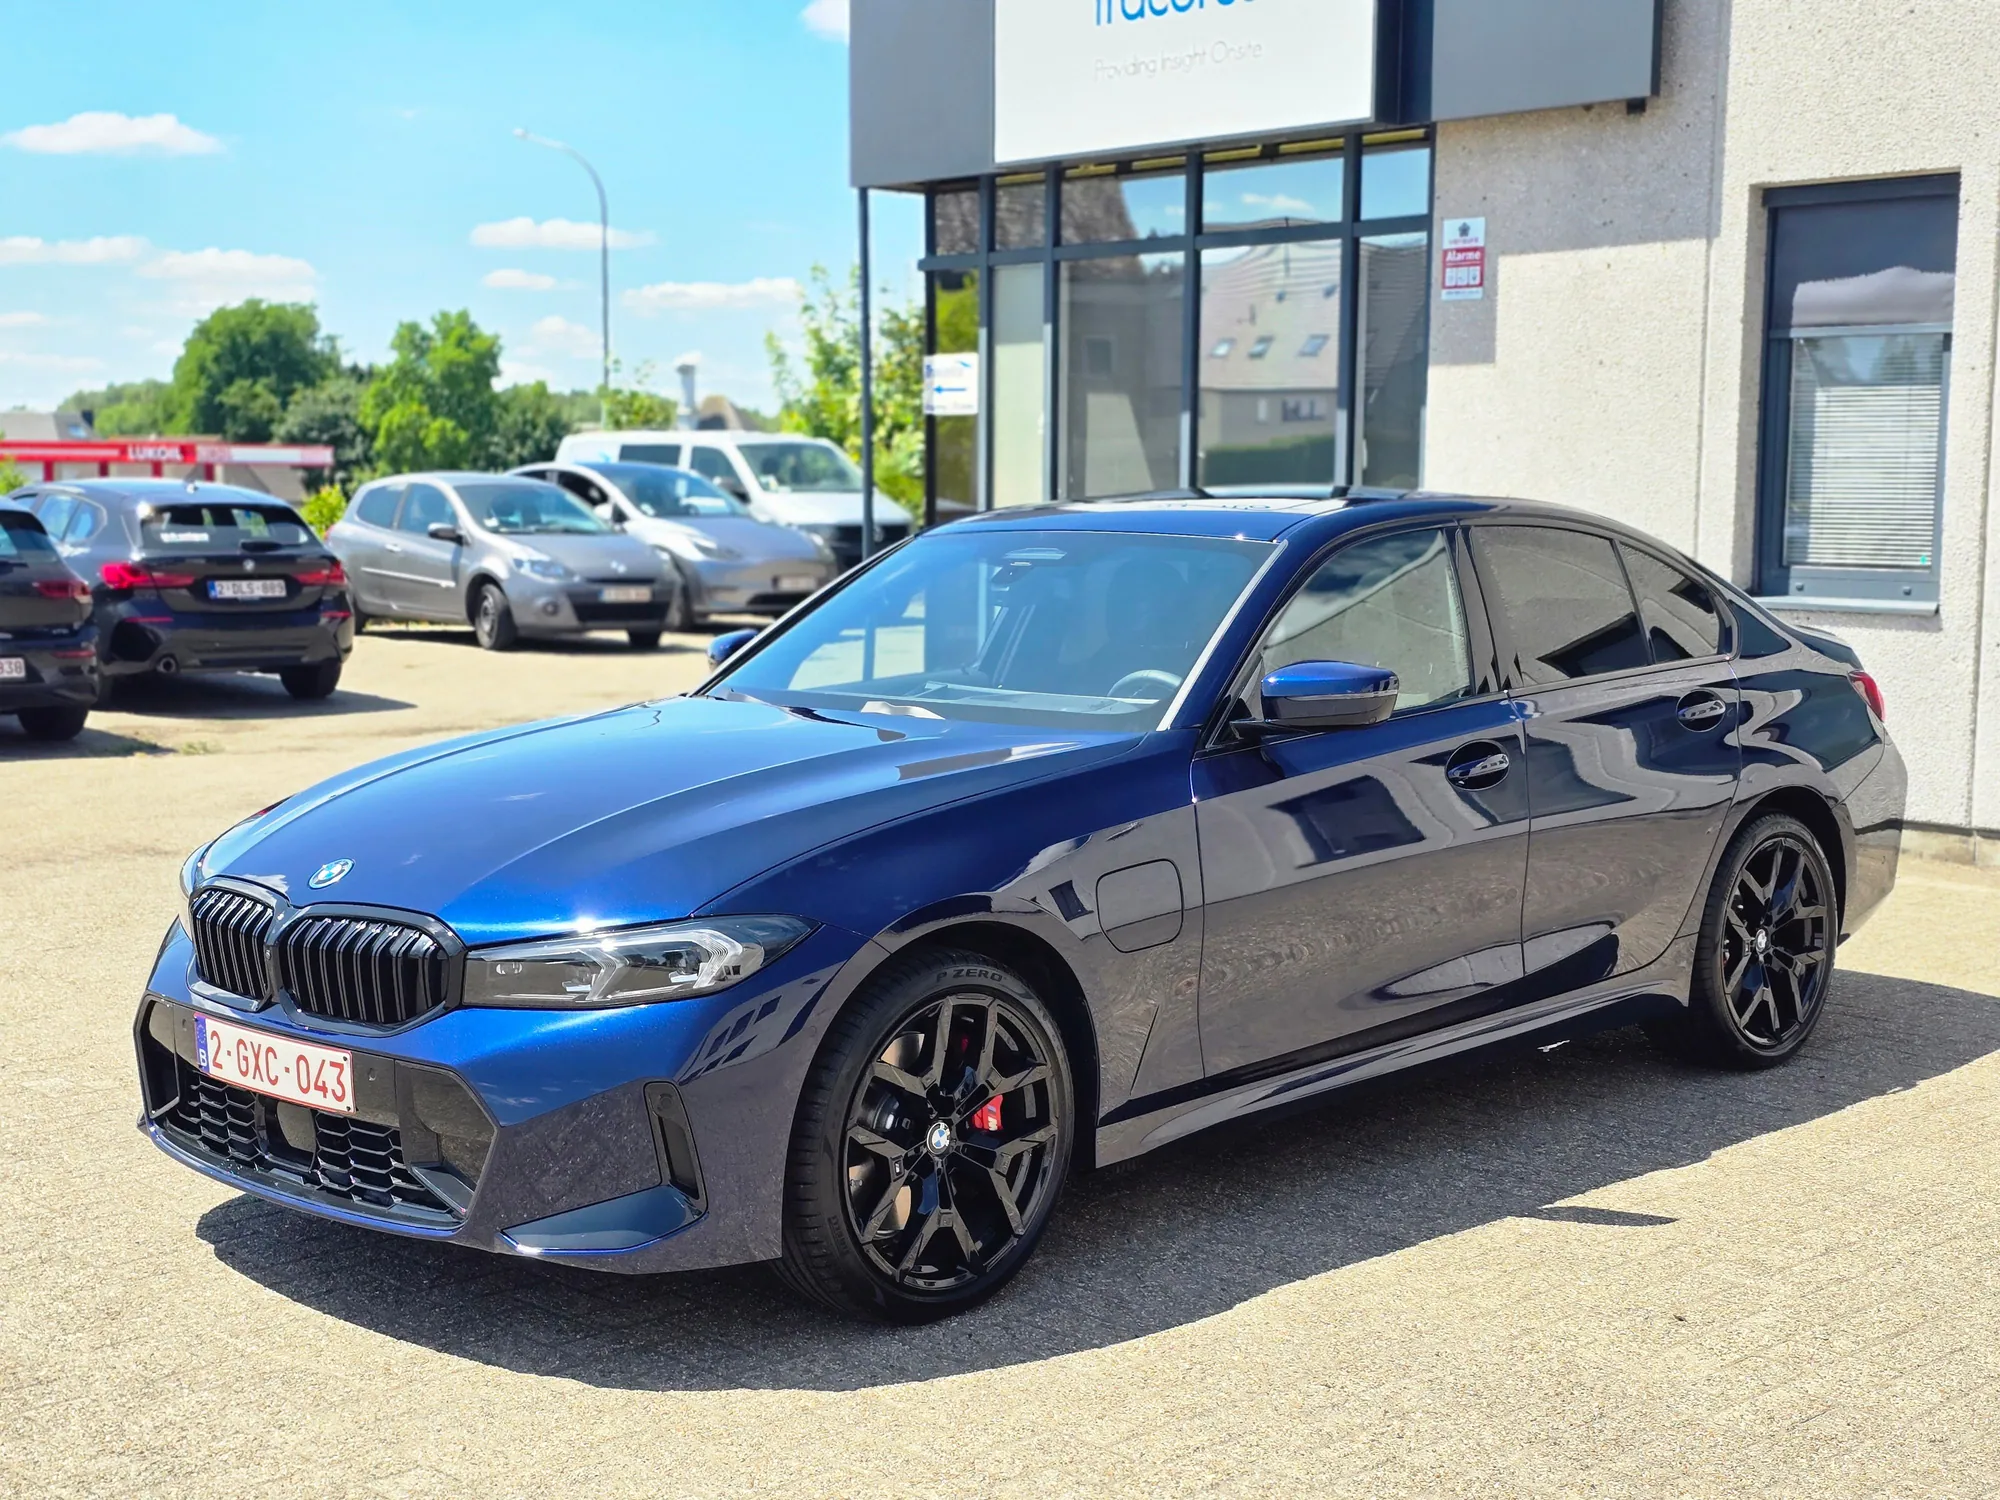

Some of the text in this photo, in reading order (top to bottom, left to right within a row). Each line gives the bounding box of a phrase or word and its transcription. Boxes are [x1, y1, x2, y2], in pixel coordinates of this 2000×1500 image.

[1446, 250, 1481, 262] Alarme
[953, 968, 1003, 982] ZERO
[199, 1048, 207, 1067] B
[210, 1030, 346, 1102] 2-GXC-043
